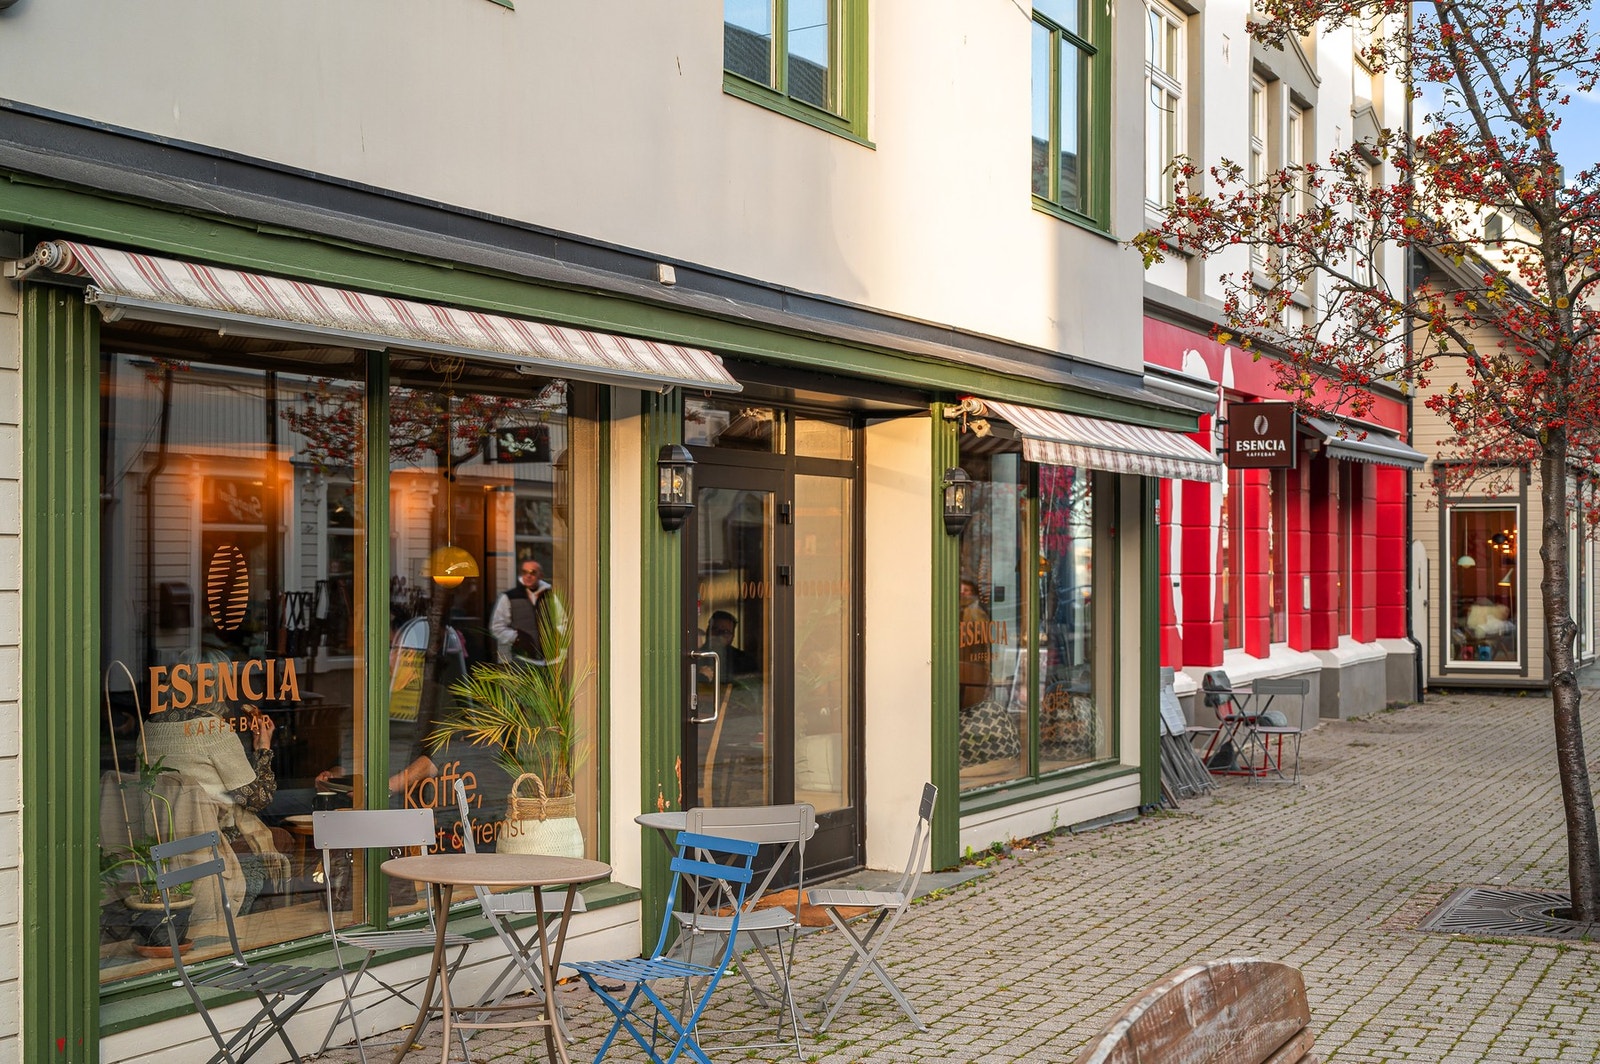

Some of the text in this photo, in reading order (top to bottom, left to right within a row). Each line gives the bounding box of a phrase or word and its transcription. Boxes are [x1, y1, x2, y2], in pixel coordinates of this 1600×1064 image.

[1236, 440, 1286, 451] ESENCIA
[960, 620, 1008, 648] ESENCIA
[148, 657, 302, 715] ESENCIA
[183, 714, 271, 737] KAFFEBAR
[404, 761, 483, 809] kaffe,
